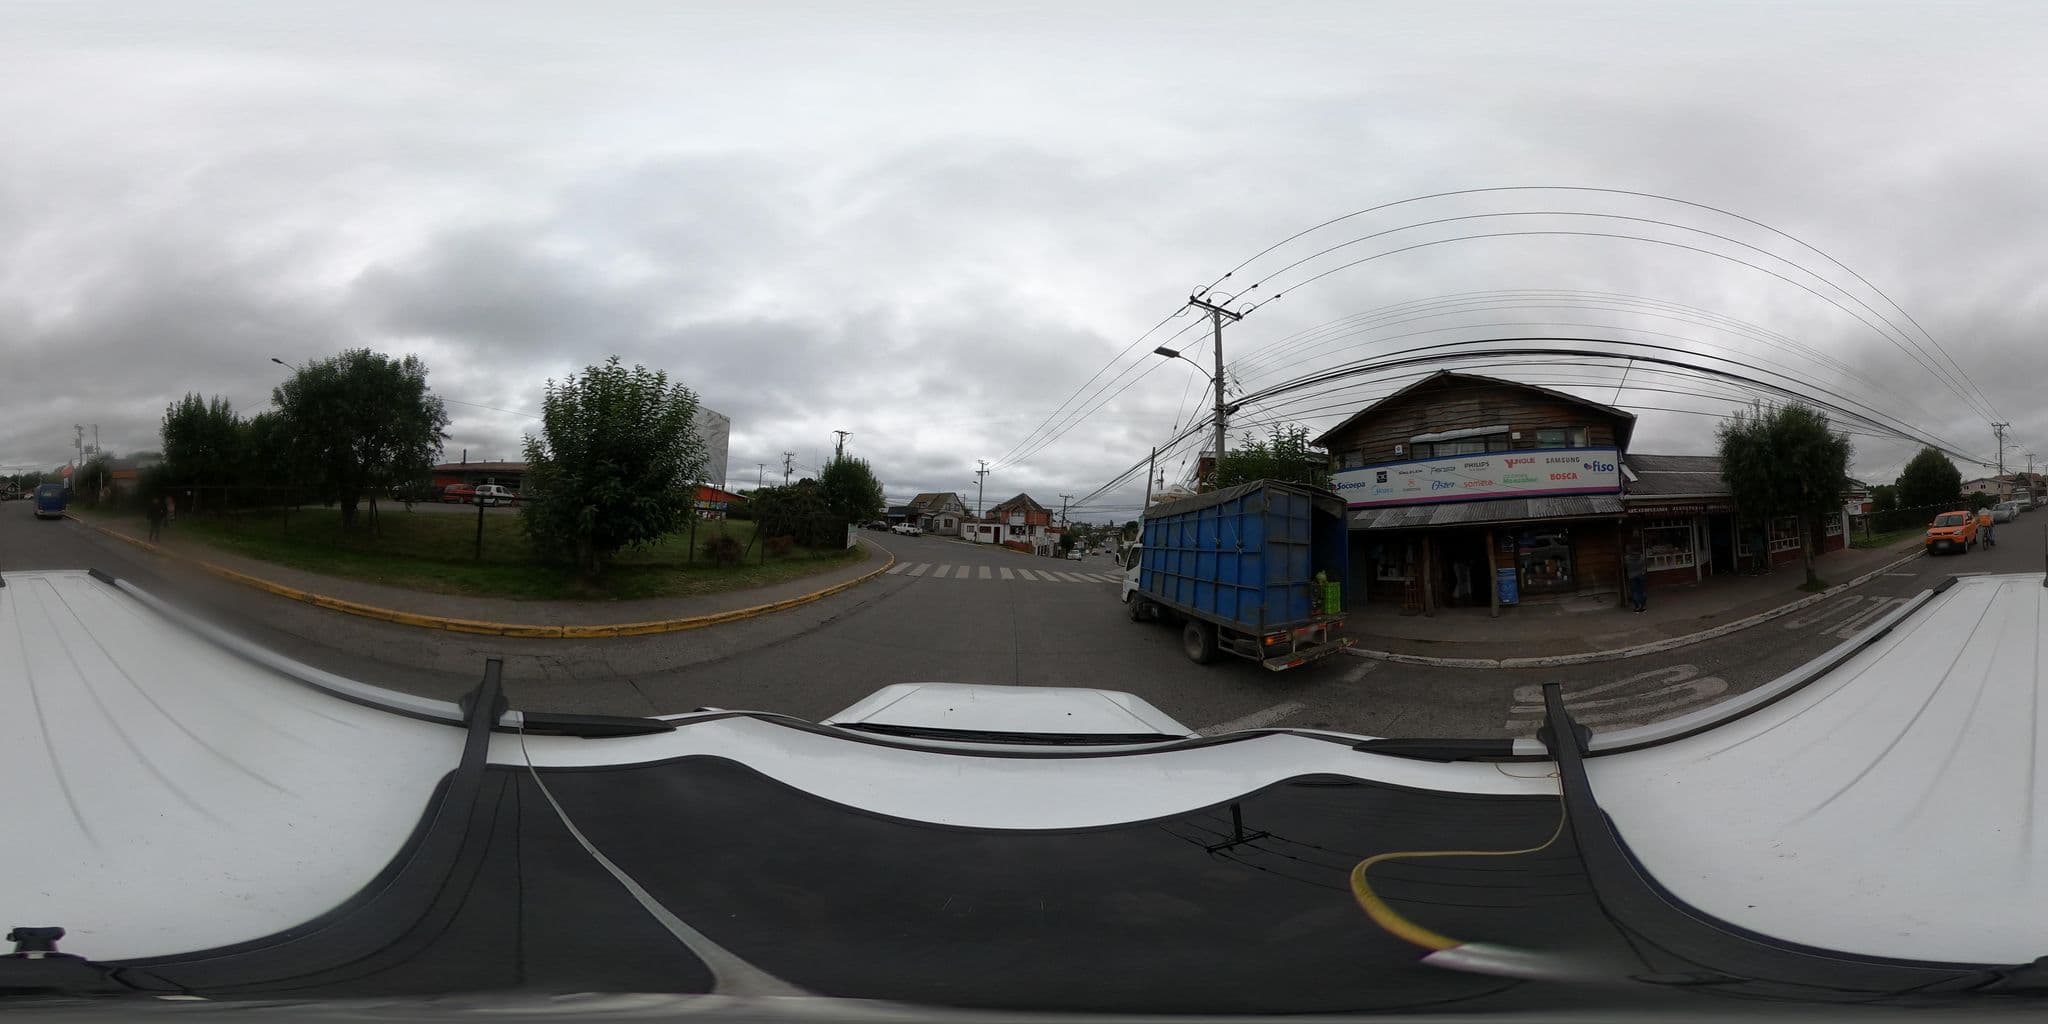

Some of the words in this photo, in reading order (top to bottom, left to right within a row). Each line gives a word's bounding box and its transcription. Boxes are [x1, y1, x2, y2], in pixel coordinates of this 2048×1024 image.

[1545, 456, 1580, 464] SAMSUNG
[1592, 460, 1614, 472] fiso
[1550, 472, 1578, 481] BOSCA
[1336, 481, 1366, 490] Socoepa
